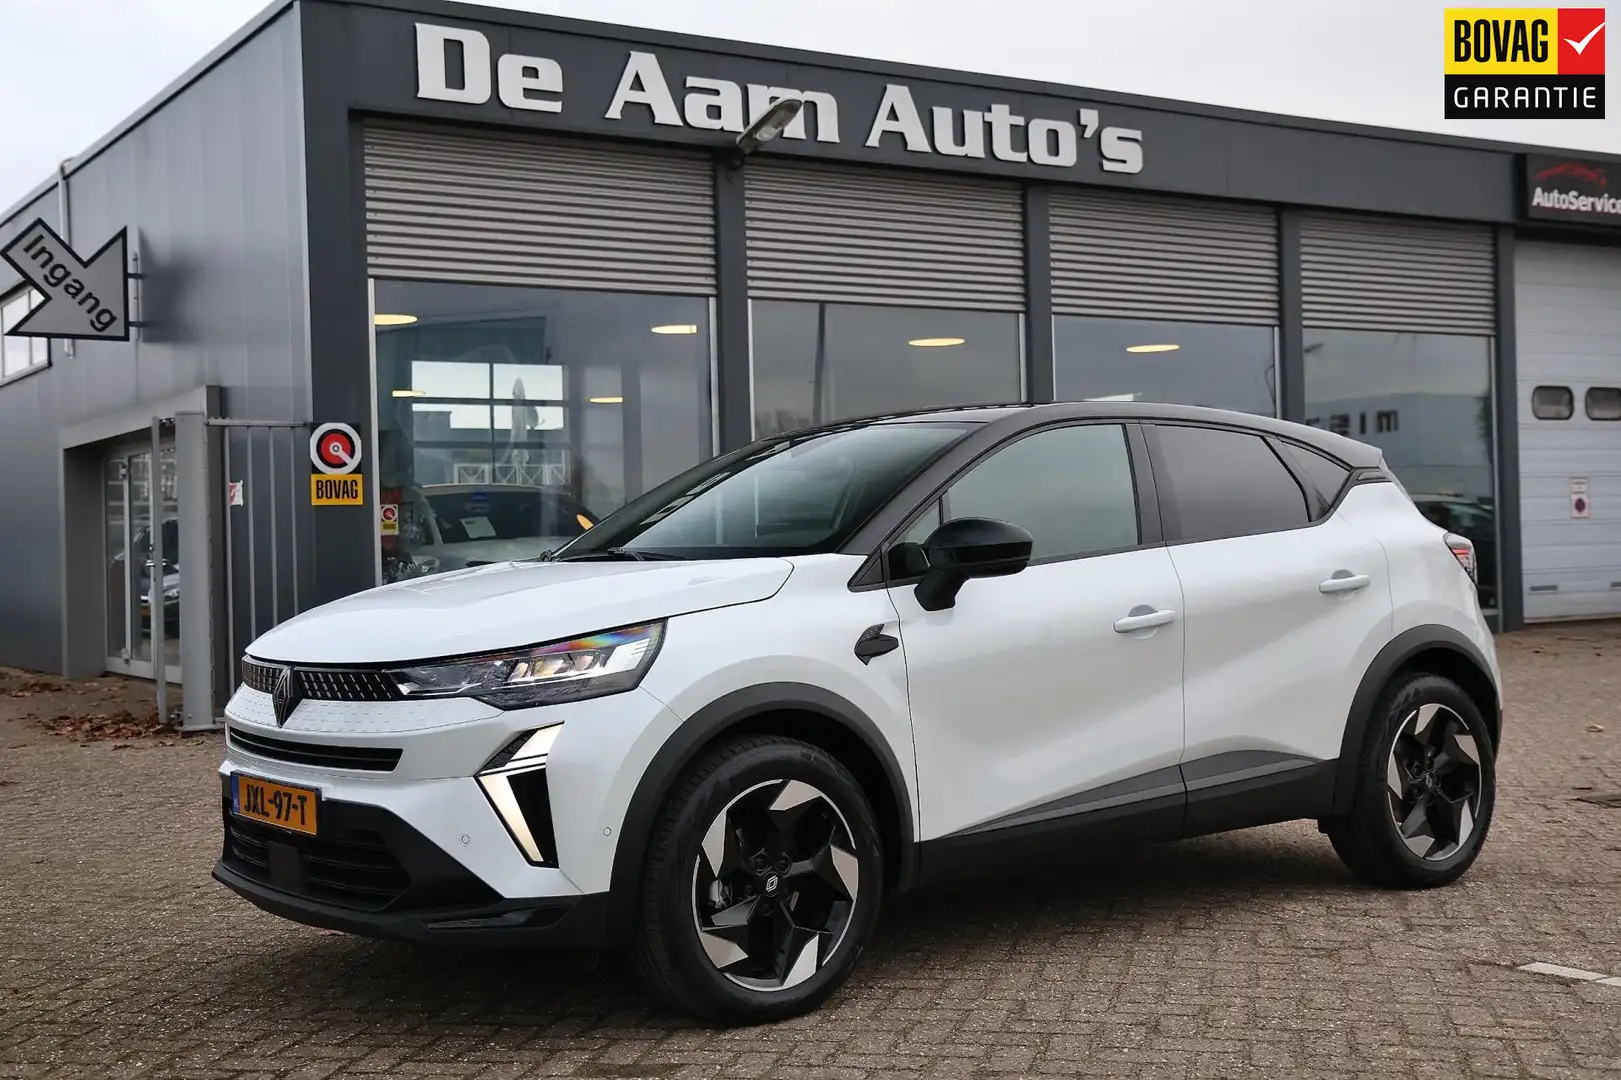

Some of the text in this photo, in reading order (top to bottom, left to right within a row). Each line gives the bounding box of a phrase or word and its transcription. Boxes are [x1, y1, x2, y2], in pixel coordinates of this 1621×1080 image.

[414, 22, 1144, 174] De Aam Auto's
[23, 234, 118, 332] Ingang
[316, 479, 358, 499] BOVAG
[244, 784, 307, 825] JXL-97-T
